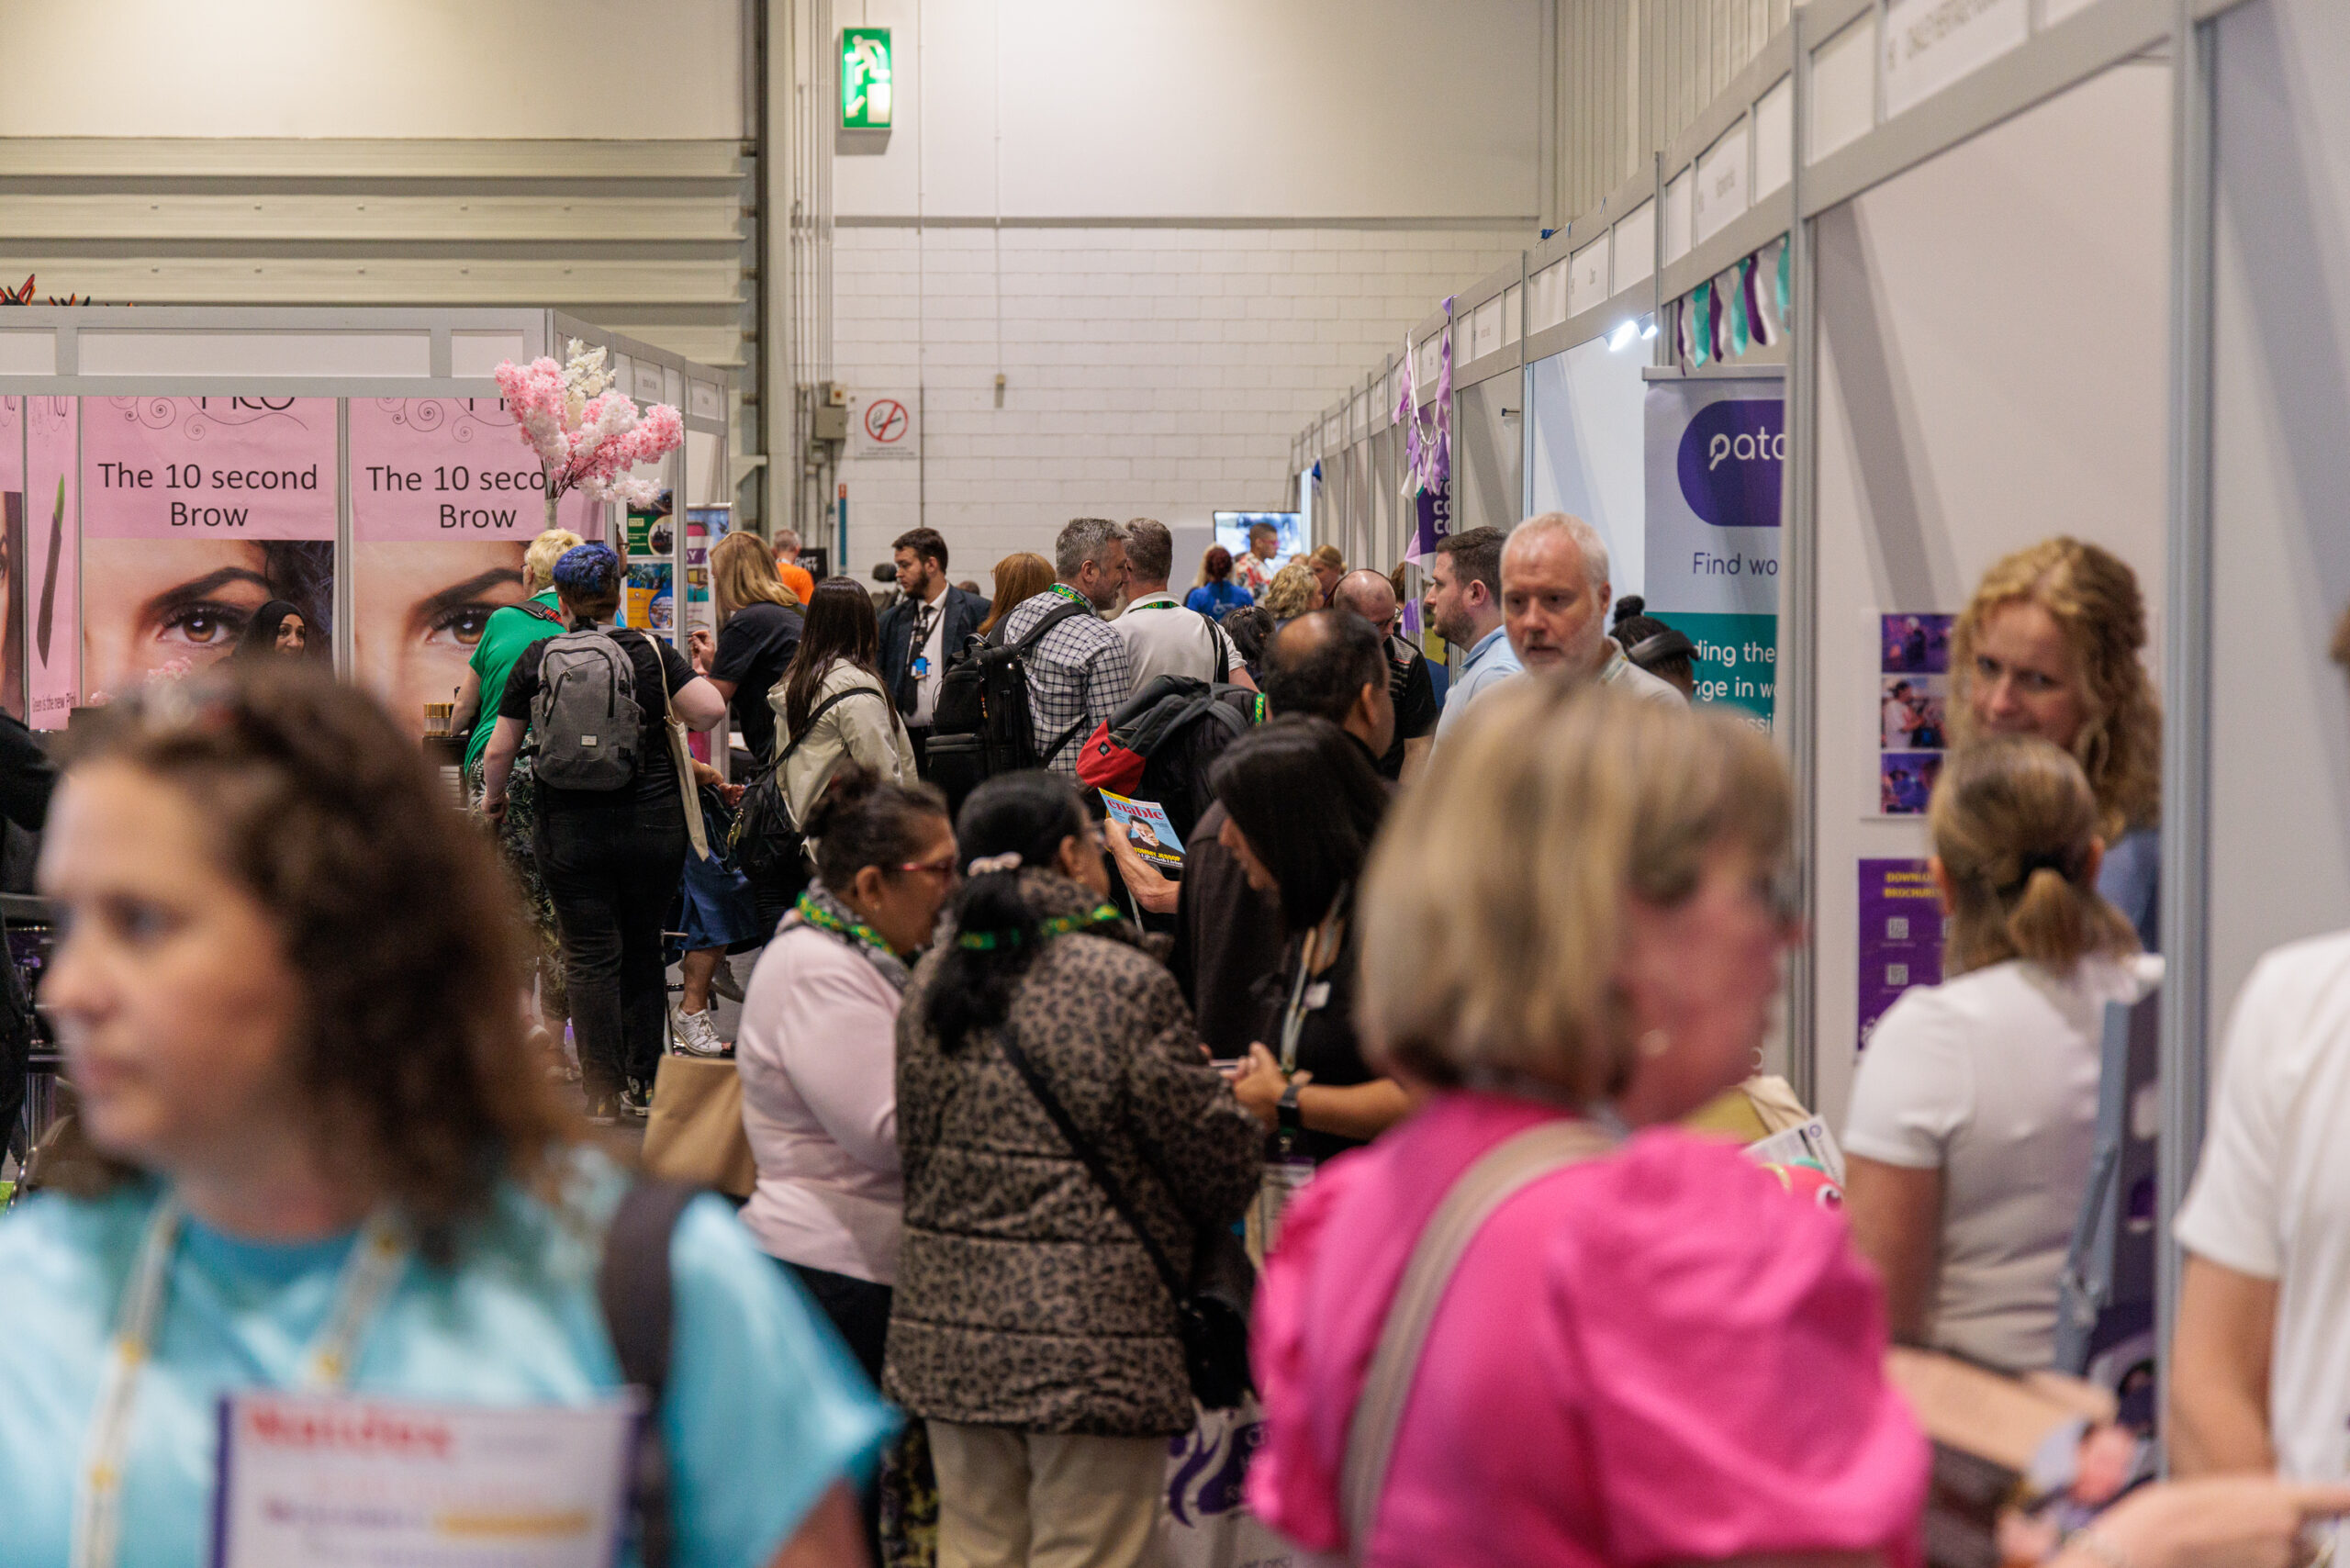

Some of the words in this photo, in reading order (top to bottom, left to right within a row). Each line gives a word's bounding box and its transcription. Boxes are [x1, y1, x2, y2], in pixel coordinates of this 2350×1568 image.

[97, 462, 153, 488] The
[166, 464, 201, 488] 10
[212, 463, 318, 489] second
[365, 465, 422, 491] The
[433, 465, 469, 491] 10
[479, 470, 580, 491] seco
[171, 502, 249, 527] Brow
[440, 504, 517, 529] Brow
[1693, 552, 1741, 575] Find
[1749, 559, 1778, 576] wo
[1743, 641, 1776, 663] the
[1735, 676, 1754, 698] in
[1106, 799, 1165, 821] enable
